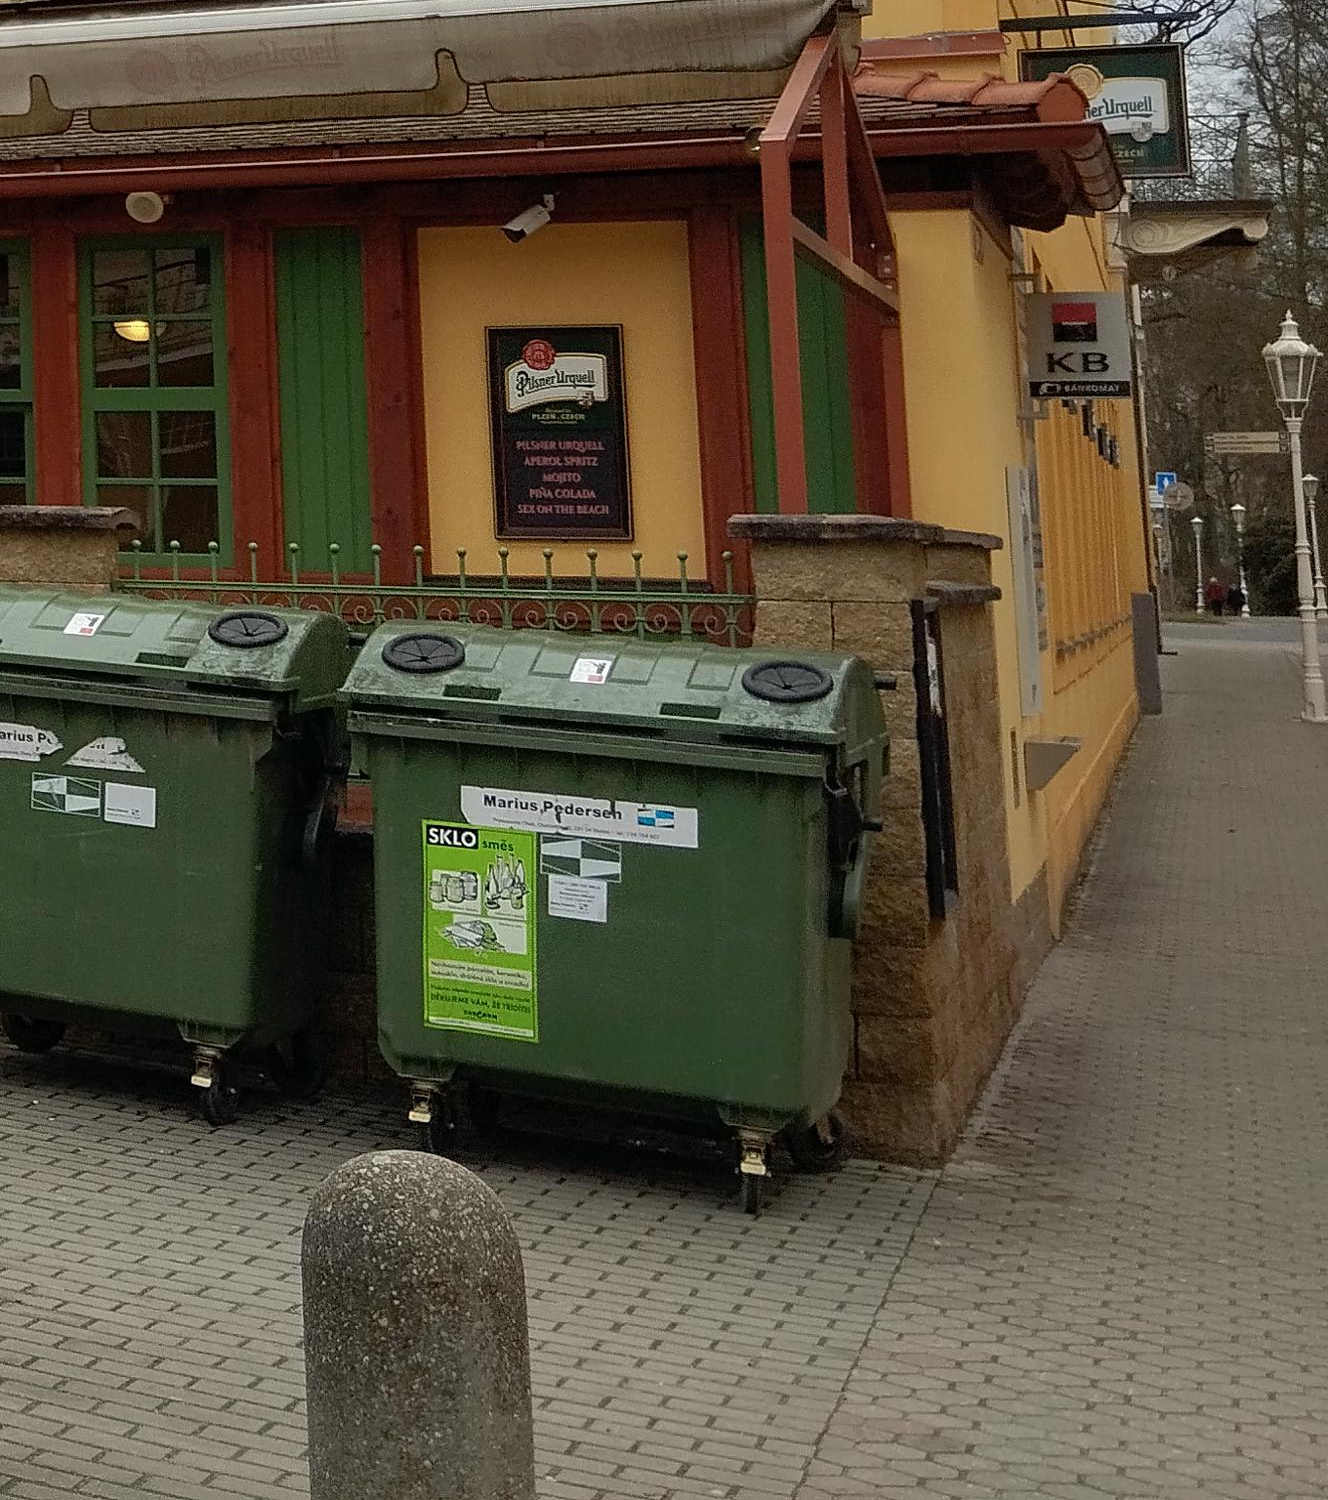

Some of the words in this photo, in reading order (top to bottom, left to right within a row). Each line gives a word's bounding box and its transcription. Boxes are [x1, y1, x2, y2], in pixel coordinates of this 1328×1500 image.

[1101, 95, 1153, 120] Urquell
[1047, 351, 1110, 373] KB
[516, 370, 556, 398] Pilsner
[554, 369, 596, 389] Urquell
[516, 440, 557, 451] PILSNER
[558, 440, 605, 453] URQUELL
[542, 472, 582, 483] MOJITO
[483, 794, 539, 813] Marius
[543, 801, 623, 821] Pedersen
[428, 827, 477, 848] SKLO
[482, 838, 514, 852] směs
